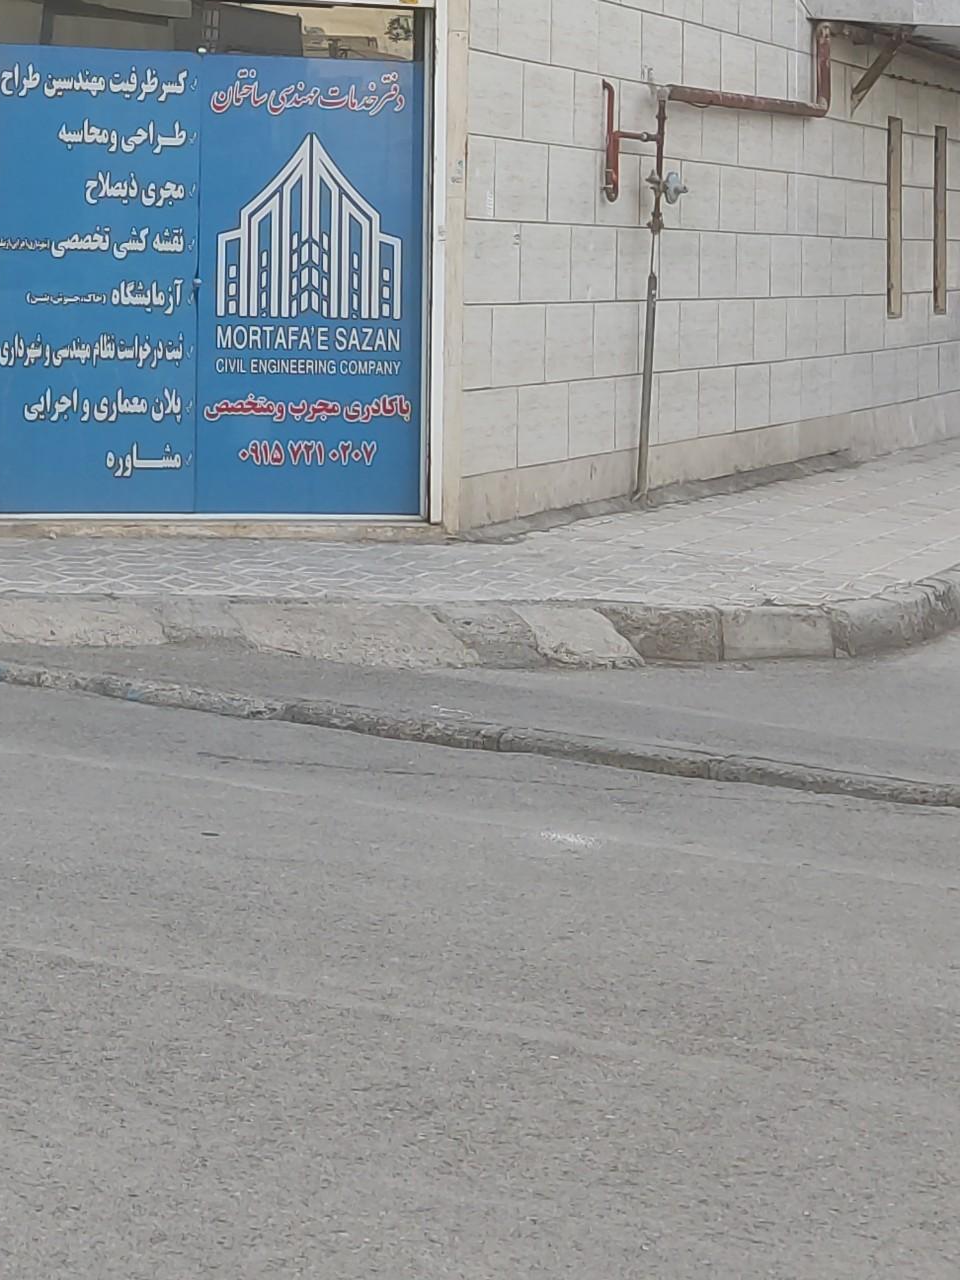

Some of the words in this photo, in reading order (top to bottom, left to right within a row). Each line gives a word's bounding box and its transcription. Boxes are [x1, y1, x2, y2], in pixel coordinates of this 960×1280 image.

[0, 63, 41, 96] طراح
[43, 70, 106, 97] مهندسین
[109, 66, 159, 101] ظرفیت
[158, 69, 188, 101] کسر
[211, 69, 268, 113] ساختمان
[369, 72, 405, 116] دفتر
[268, 82, 320, 115] مهندسی
[318, 82, 379, 111] خدمات
[121, 120, 187, 154] طراحی
[85, 171, 138, 204] ذیصلاح
[141, 181, 185, 207] مجری
[51, 225, 111, 258] تخصصی
[113, 227, 149, 259] کشی
[152, 227, 185, 252] نقشه
[111, 279, 183, 314] آزمایشگاه
[0, 333, 42, 367] شهرداری
[52, 337, 91, 366] مهندسی
[93, 332, 116, 367] نظام
[165, 332, 184, 367] ثبت
[335, 327, 400, 351] SAZAN
[216, 358, 247, 373] CIVIL
[251, 359, 336, 374] ENGINEERING
[340, 360, 401, 375] COMPANY
[24, 387, 78, 421] اجرایی
[81, 398, 90, 421] و
[93, 388, 148, 421] معماری
[152, 388, 182, 423] پلان
[288, 397, 341, 422] مجرب
[106, 442, 182, 476] مشاوره
[238, 440, 284, 465] ۰۹۱۵
[288, 440, 325, 465] ۷۲۱
[329, 441, 377, 466] ۰۲۰۷
